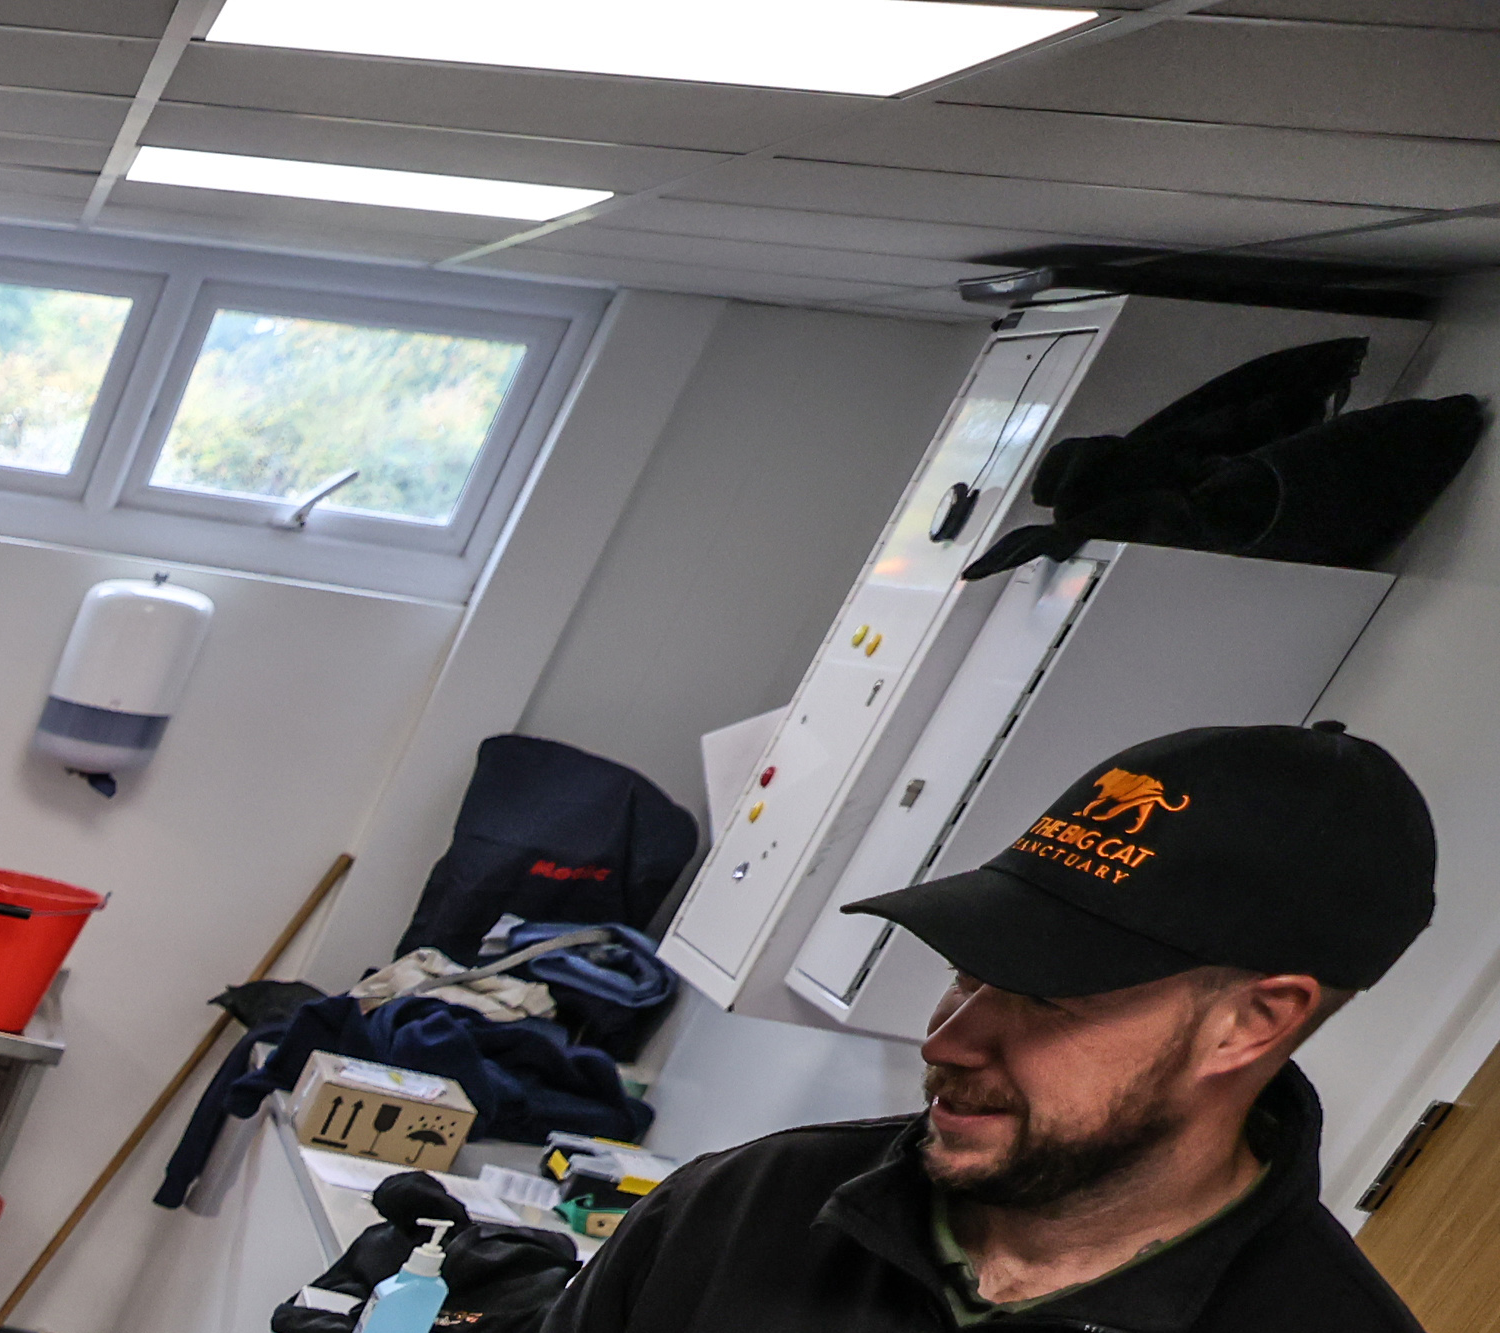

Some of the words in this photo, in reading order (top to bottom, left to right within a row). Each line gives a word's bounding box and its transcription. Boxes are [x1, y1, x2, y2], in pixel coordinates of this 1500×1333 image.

[1011, 836, 1130, 885] SANCTUARY
[1029, 816, 1060, 840] THE
[1057, 822, 1101, 850] BIG
[1096, 837, 1156, 869] CAT
